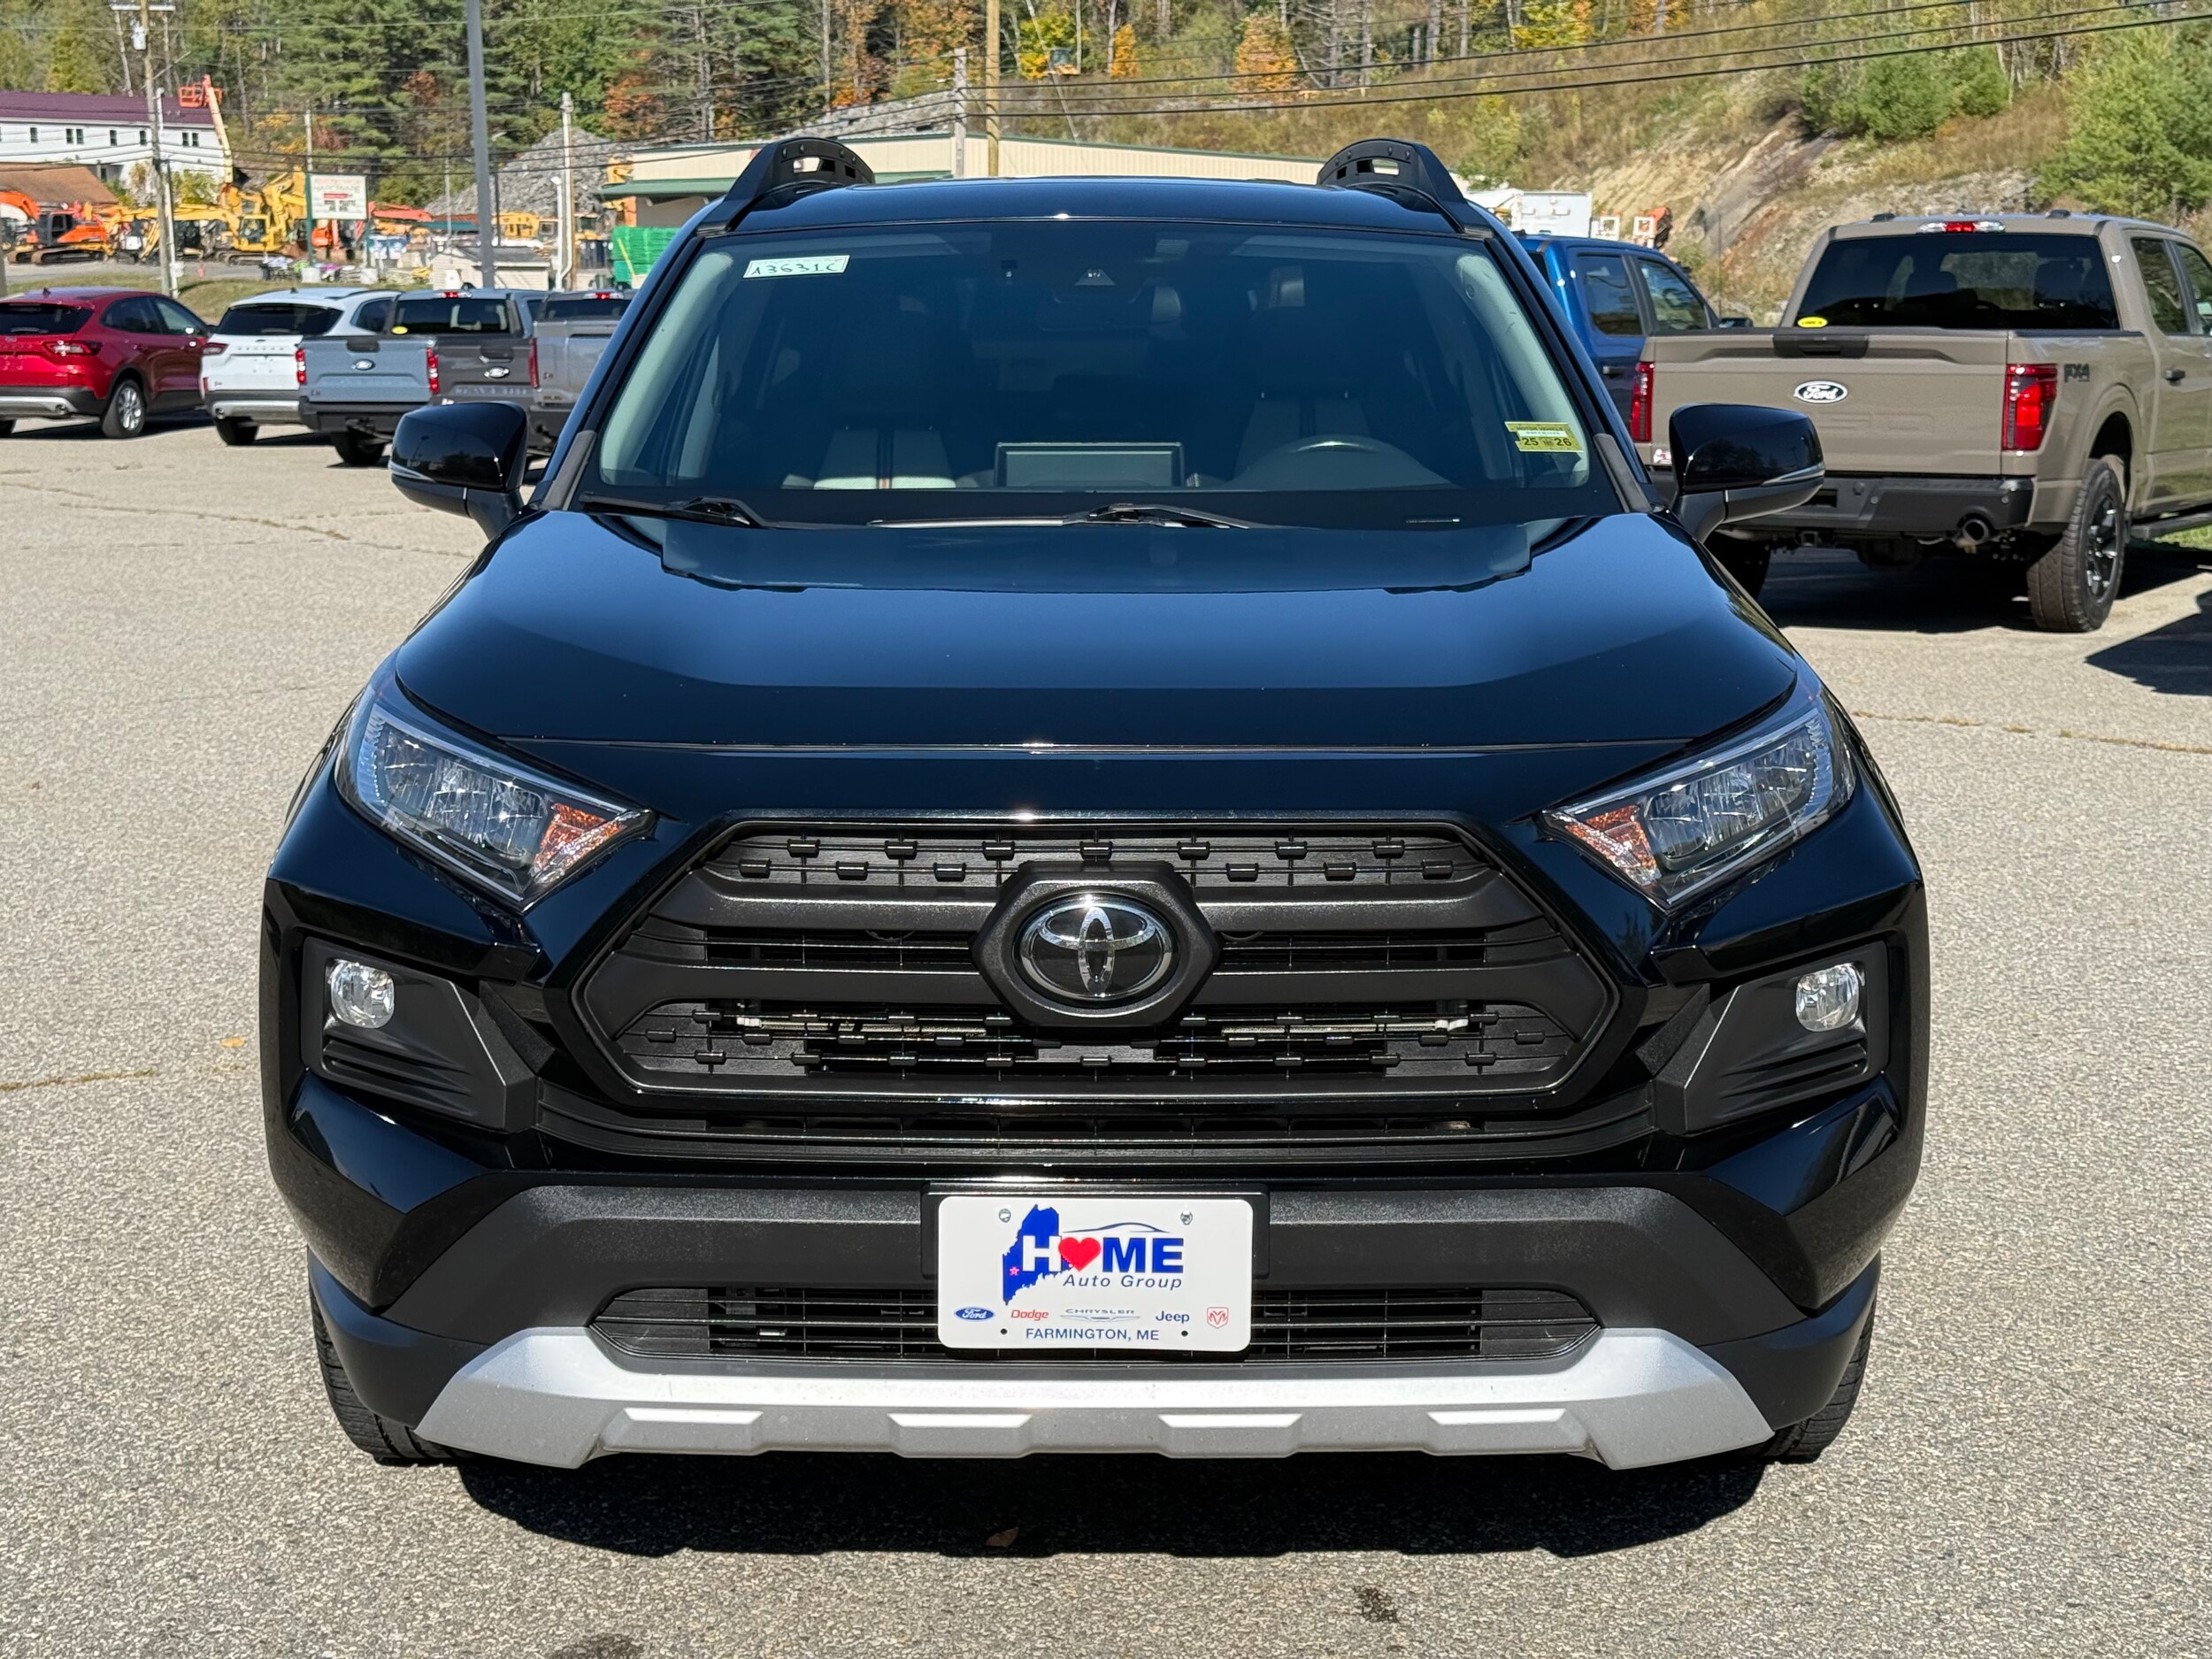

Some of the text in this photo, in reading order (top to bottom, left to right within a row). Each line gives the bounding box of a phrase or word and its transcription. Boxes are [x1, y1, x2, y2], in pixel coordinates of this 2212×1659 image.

[1522, 437, 1540, 446] 25
[1554, 438, 1572, 447] 26
[1063, 1274, 1182, 1291] Auto Group
[1010, 1310, 1049, 1321] Dodge
[1156, 1310, 1190, 1324] Jeep
[1025, 1328, 1160, 1341] FARMINGTON, ME
